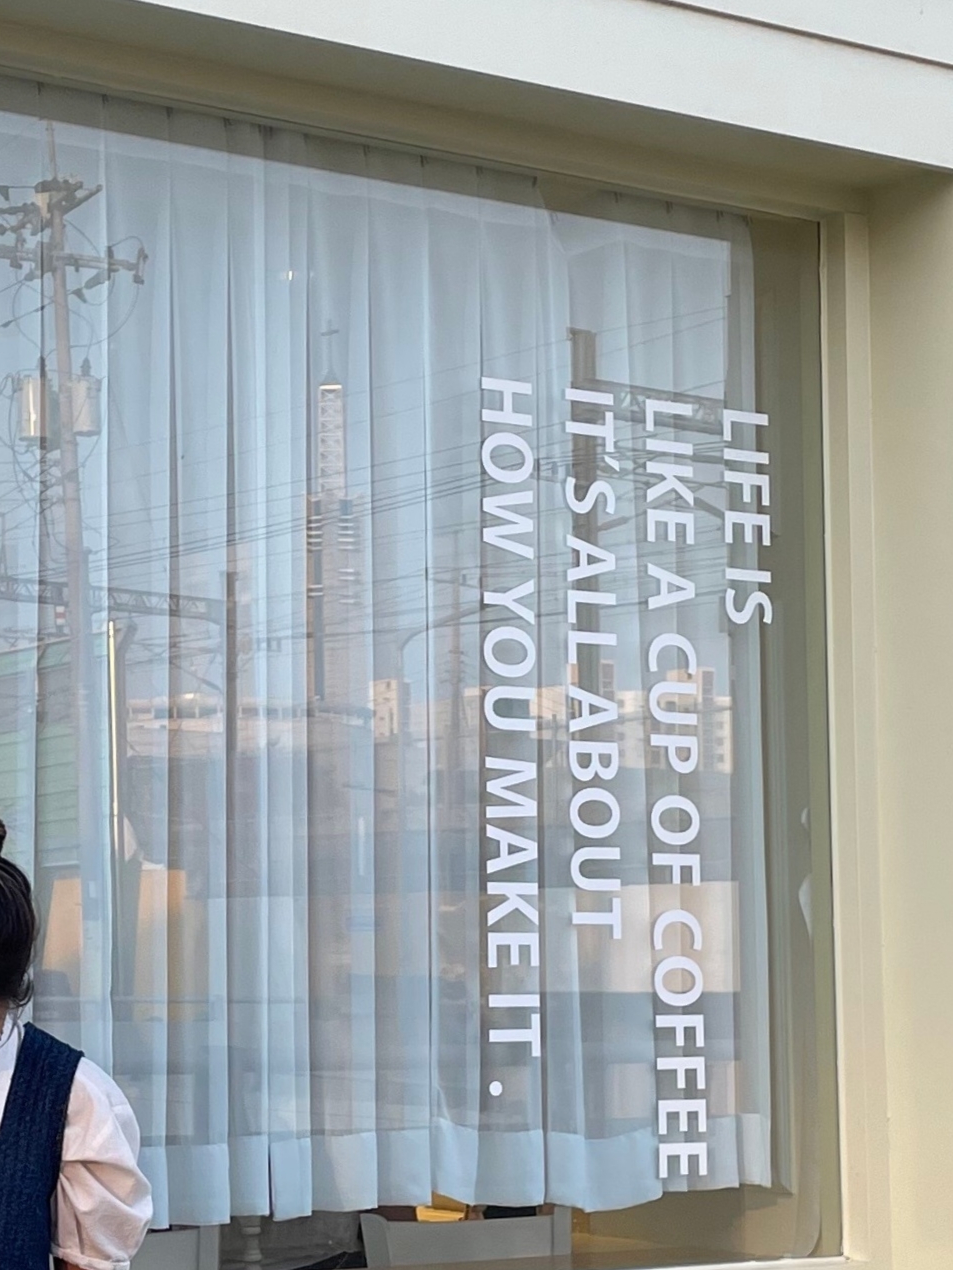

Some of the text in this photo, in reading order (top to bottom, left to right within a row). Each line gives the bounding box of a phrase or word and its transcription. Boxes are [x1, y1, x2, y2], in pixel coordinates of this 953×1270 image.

[481, 376, 535, 560] HOW
[723, 408, 773, 625] LIFE IS
[482, 578, 537, 732] YOU
[565, 387, 622, 939] IT'S ALL ABOUT
[484, 755, 540, 968] MAKE
[645, 398, 708, 1179] LIKE A CUP OF COFFEE
